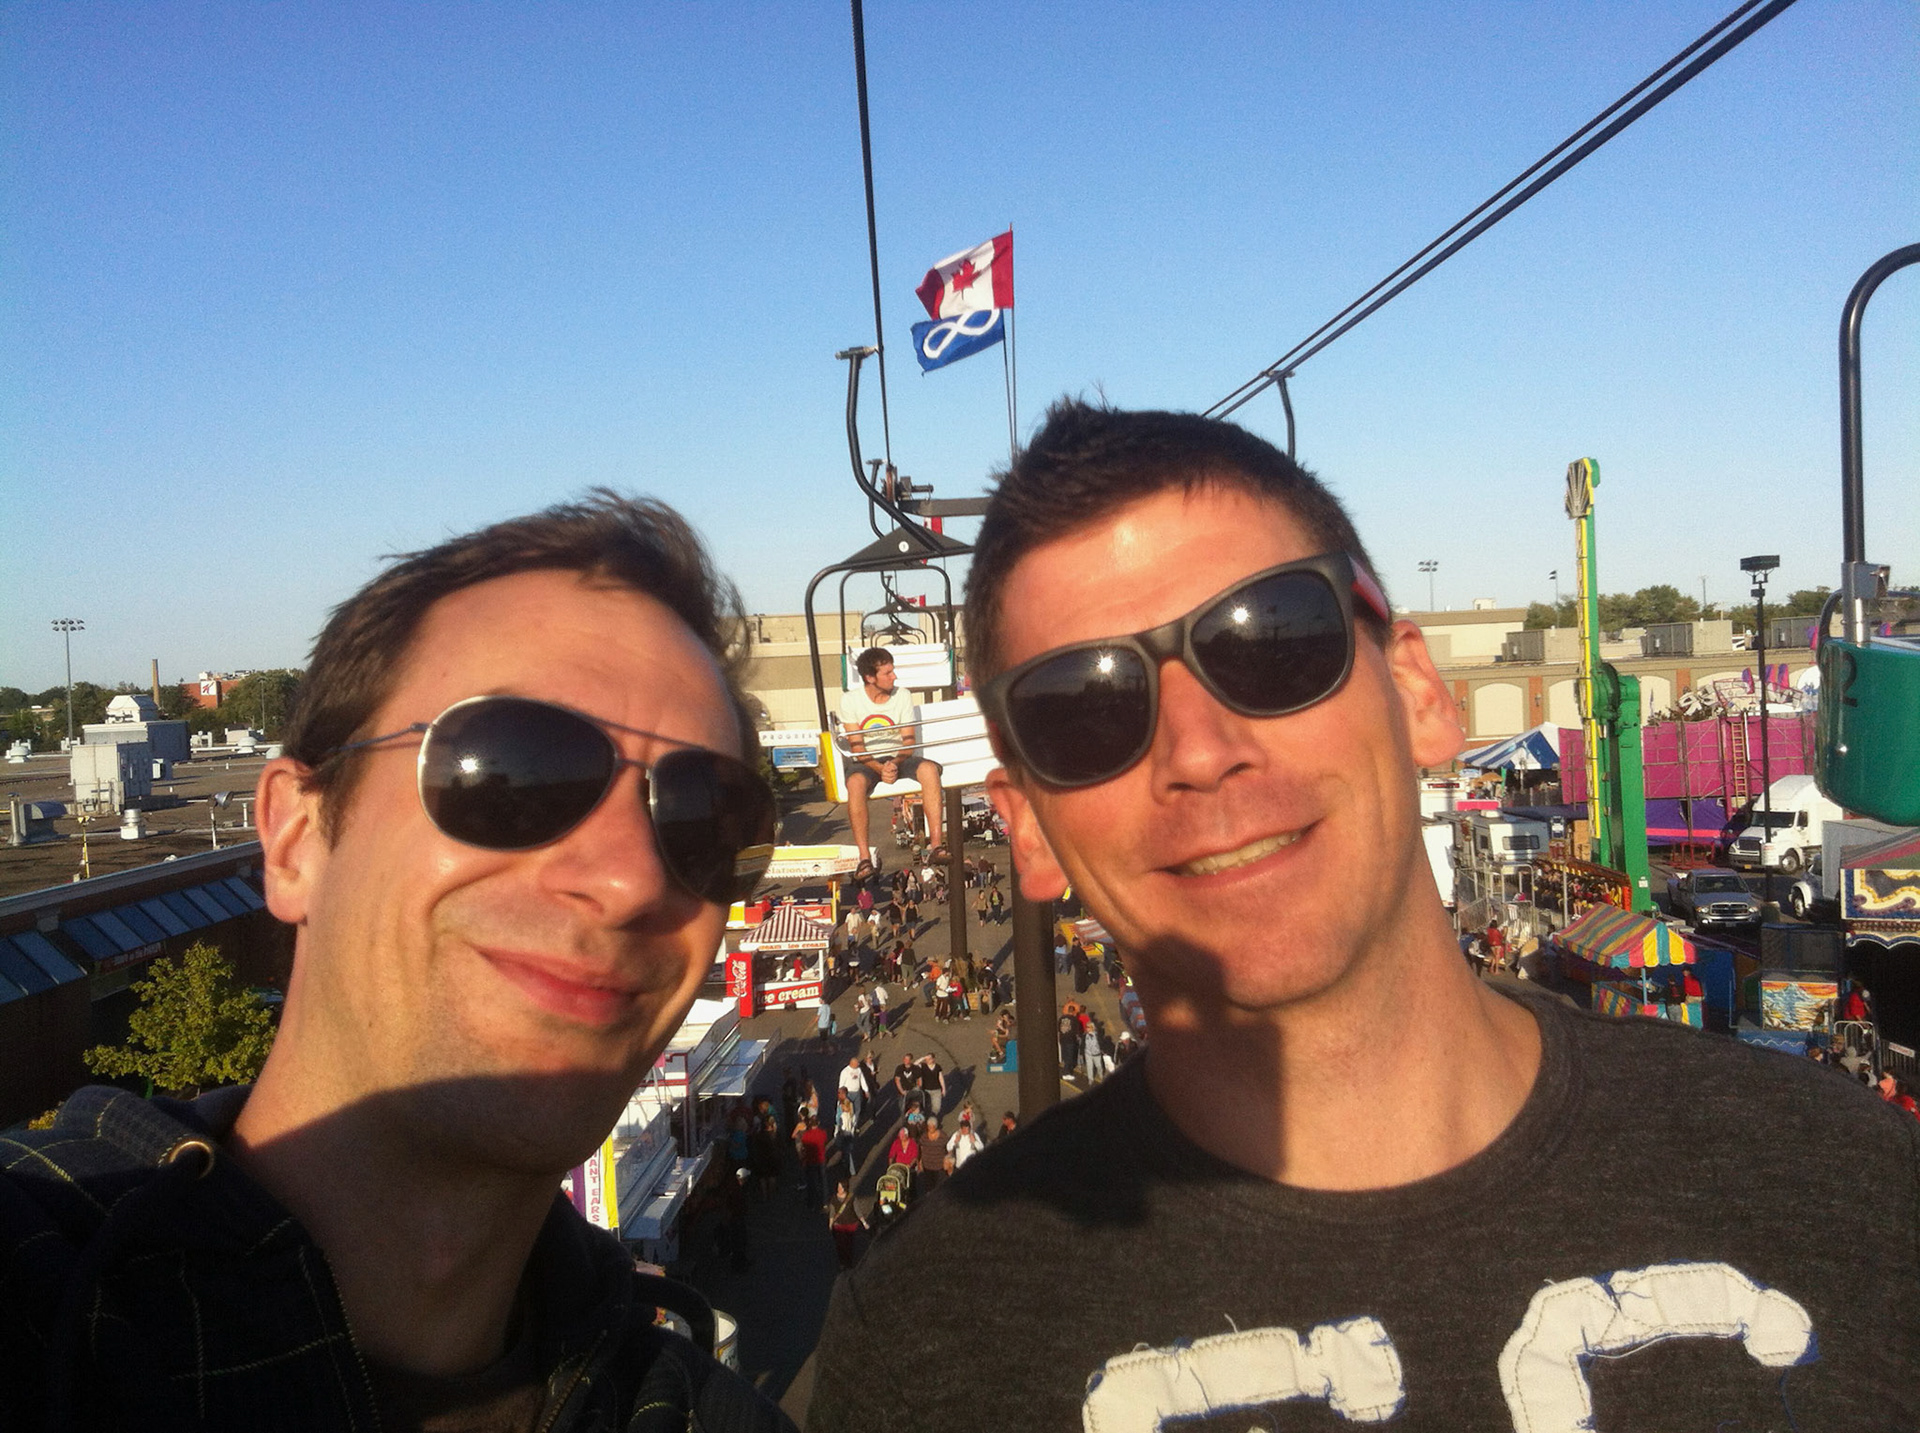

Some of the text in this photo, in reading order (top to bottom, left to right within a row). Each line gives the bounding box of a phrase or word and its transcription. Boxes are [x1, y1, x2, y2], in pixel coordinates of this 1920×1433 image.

[777, 985, 820, 1002] cream
[588, 1150, 600, 1222] ANT EARS
